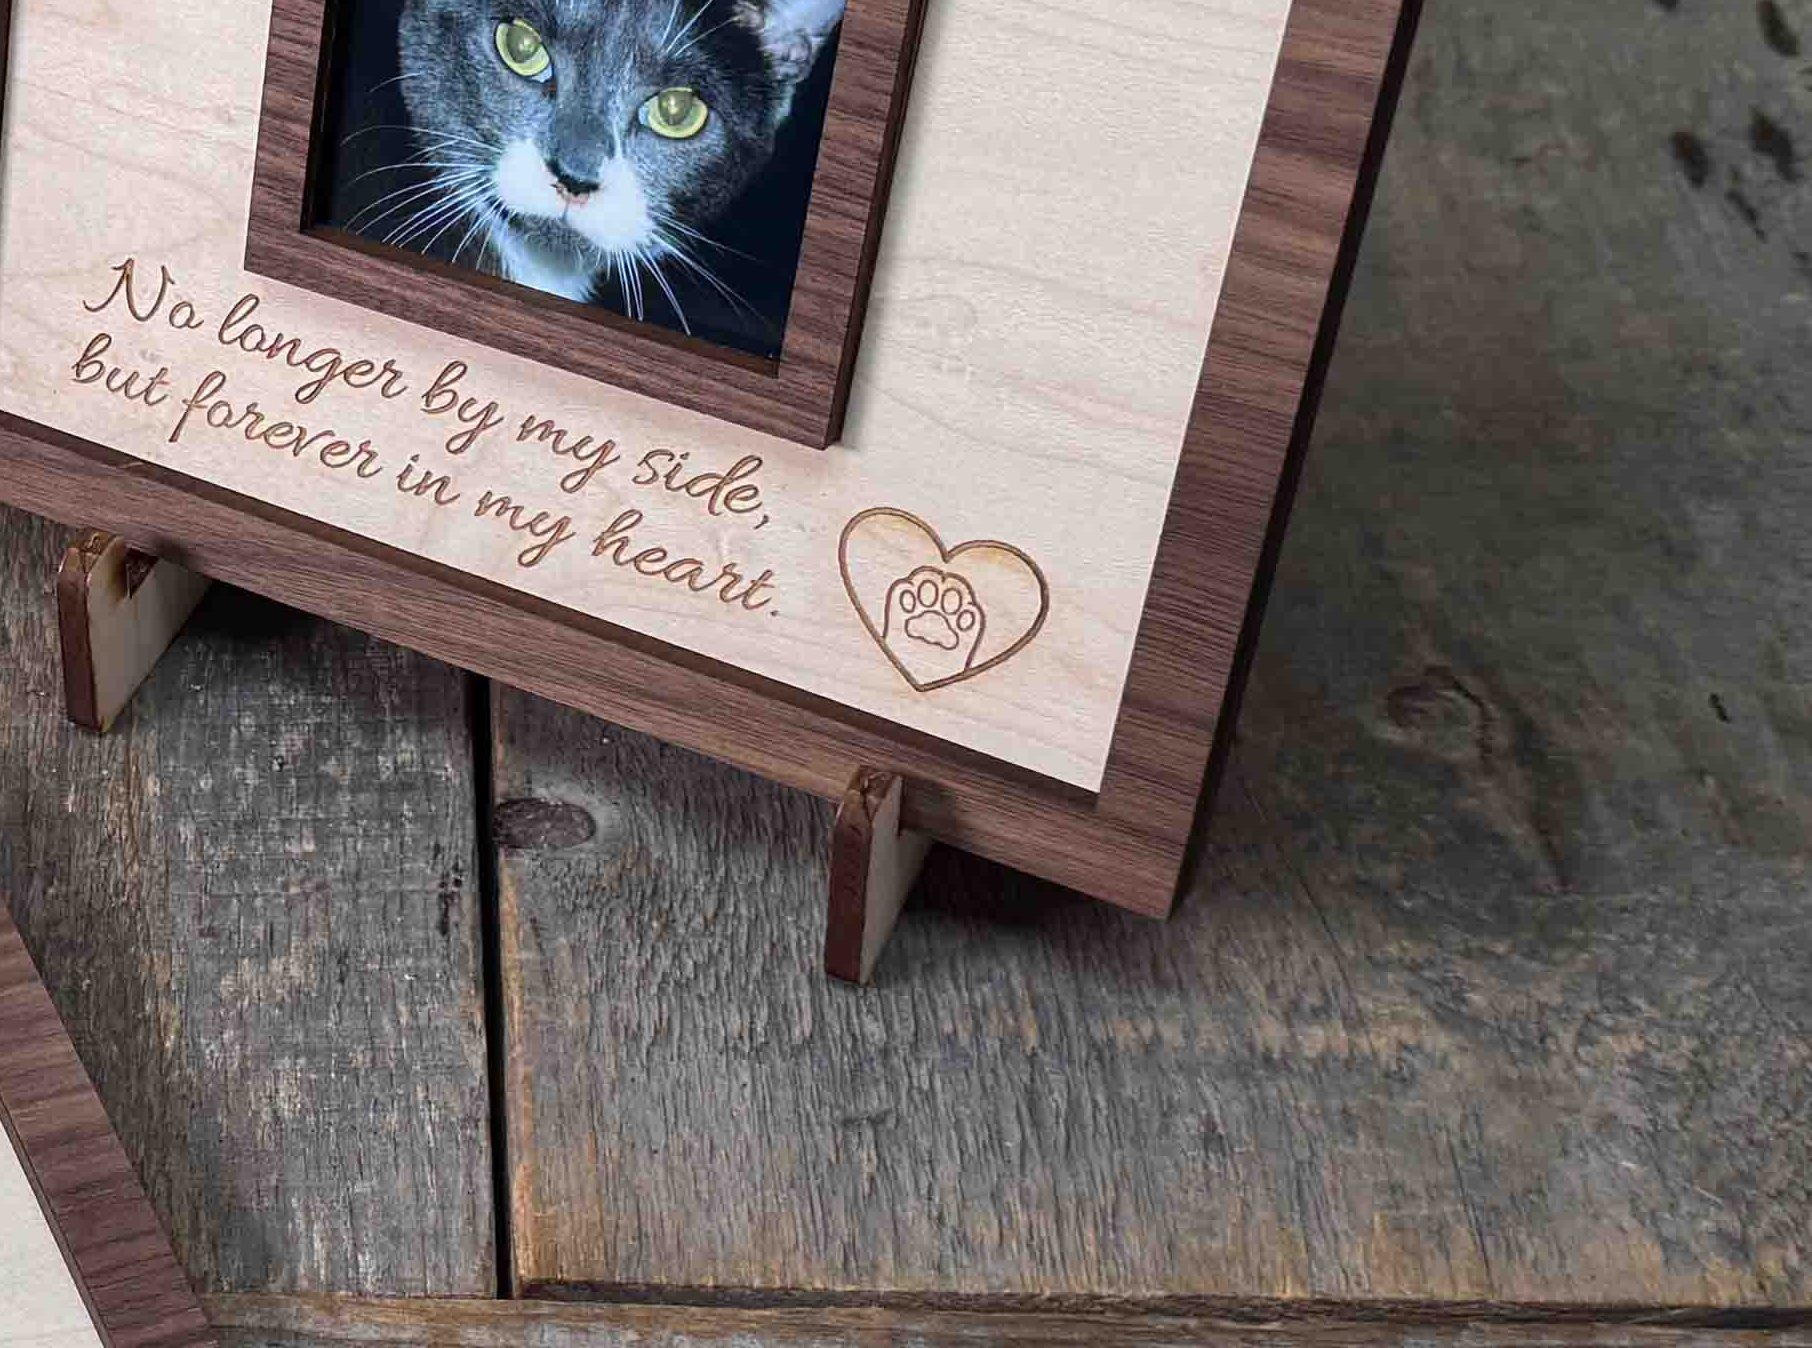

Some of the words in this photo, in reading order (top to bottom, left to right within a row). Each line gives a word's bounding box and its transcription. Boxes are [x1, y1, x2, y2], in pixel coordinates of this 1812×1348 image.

[71, 333, 169, 408] but
[167, 371, 382, 480] forever
[396, 453, 461, 506] in
[474, 489, 576, 568] my
[592, 509, 781, 617] heart.
[83, 258, 204, 330] No
[217, 294, 408, 405] longer
[421, 361, 502, 453] by
[517, 411, 621, 494] my
[632, 448, 771, 530] side,
